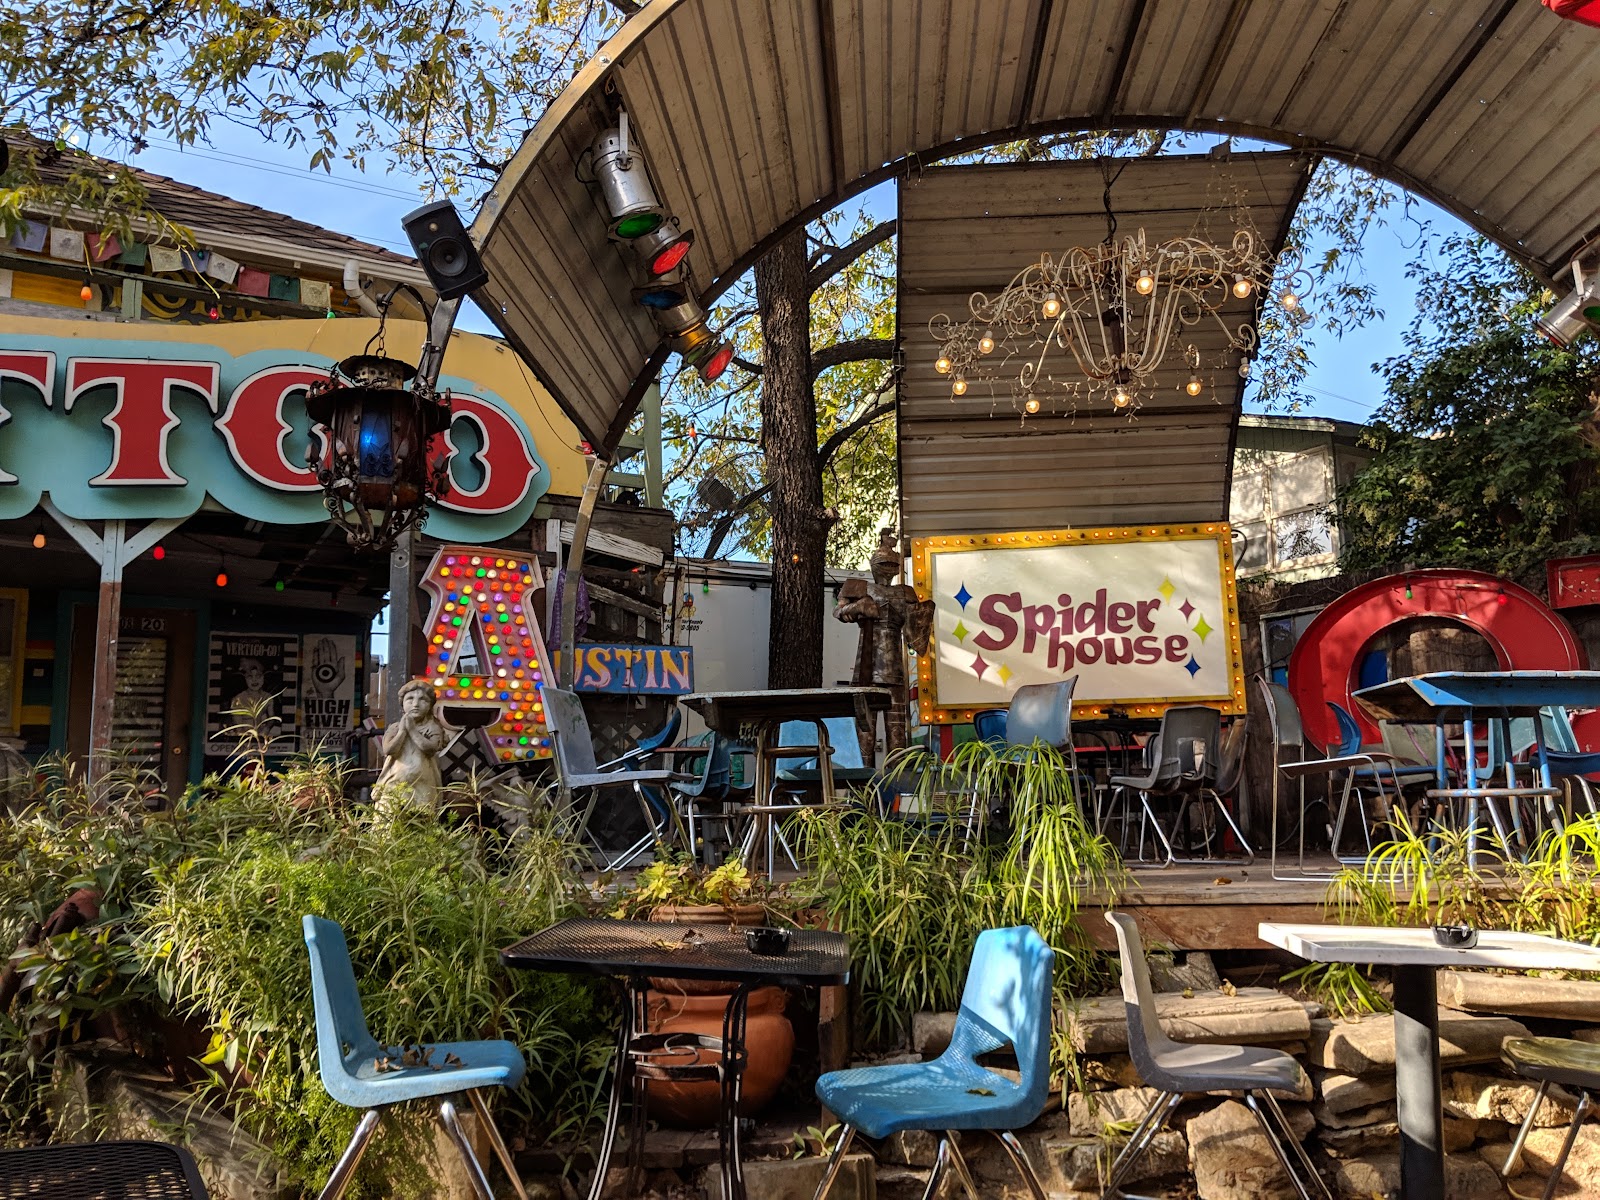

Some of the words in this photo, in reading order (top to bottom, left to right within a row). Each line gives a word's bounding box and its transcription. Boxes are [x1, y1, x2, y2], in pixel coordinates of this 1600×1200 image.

[973, 587, 1162, 654] Spider
[1046, 625, 1190, 674] house
[304, 698, 351, 715] HIGH
[305, 714, 348, 728] FIVE!
